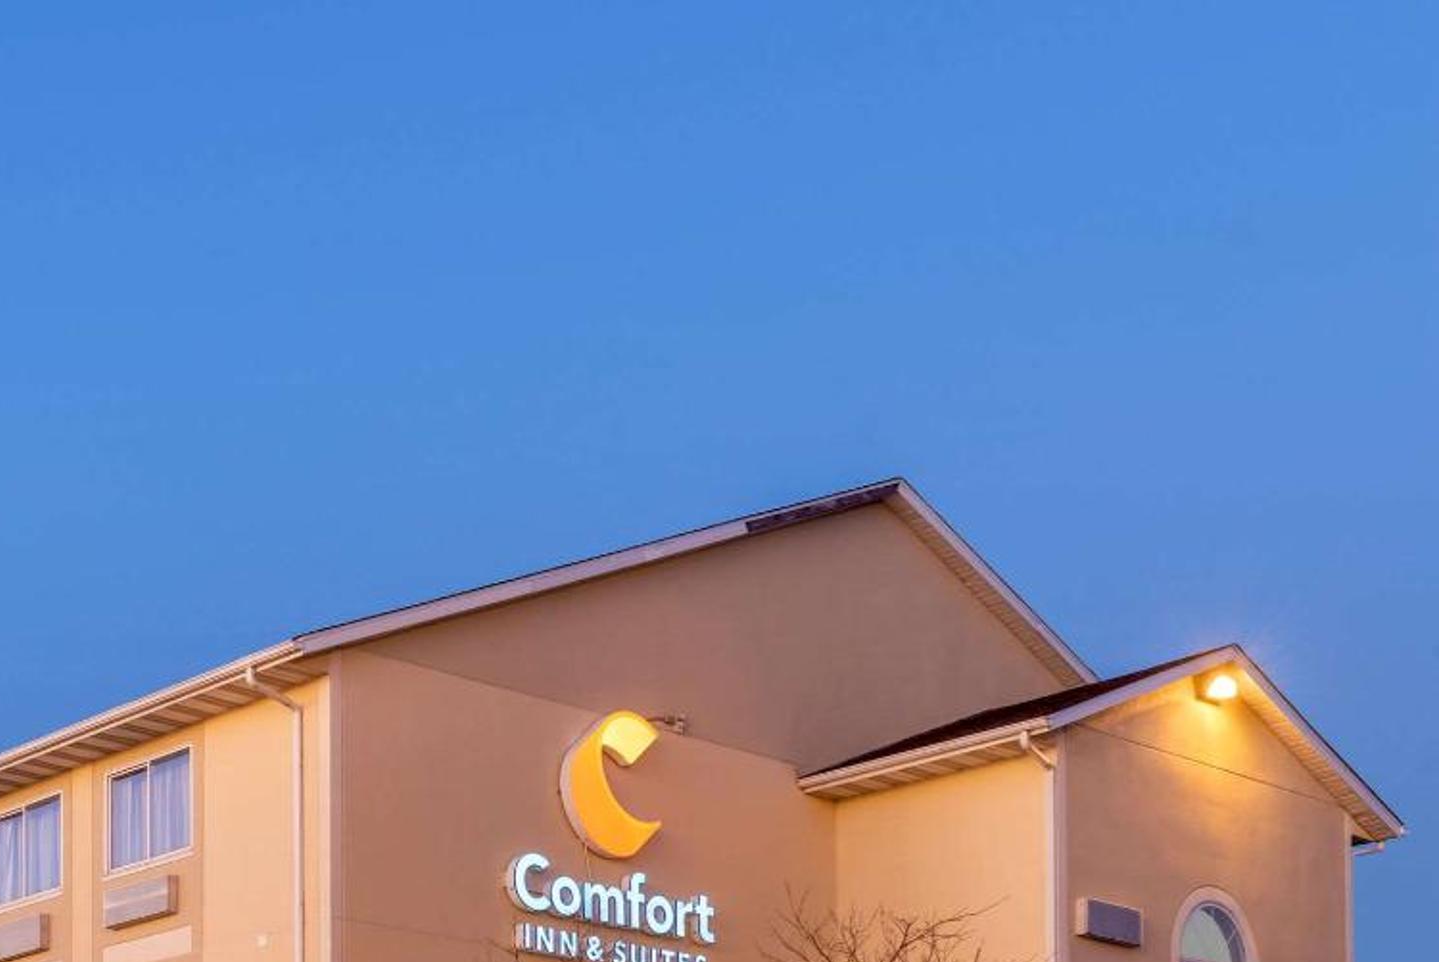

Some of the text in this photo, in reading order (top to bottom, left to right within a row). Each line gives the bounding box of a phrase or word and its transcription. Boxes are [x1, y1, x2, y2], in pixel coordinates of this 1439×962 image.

[509, 853, 715, 943] Comfort
[517, 923, 577, 956] INN
[586, 936, 604, 961] &
